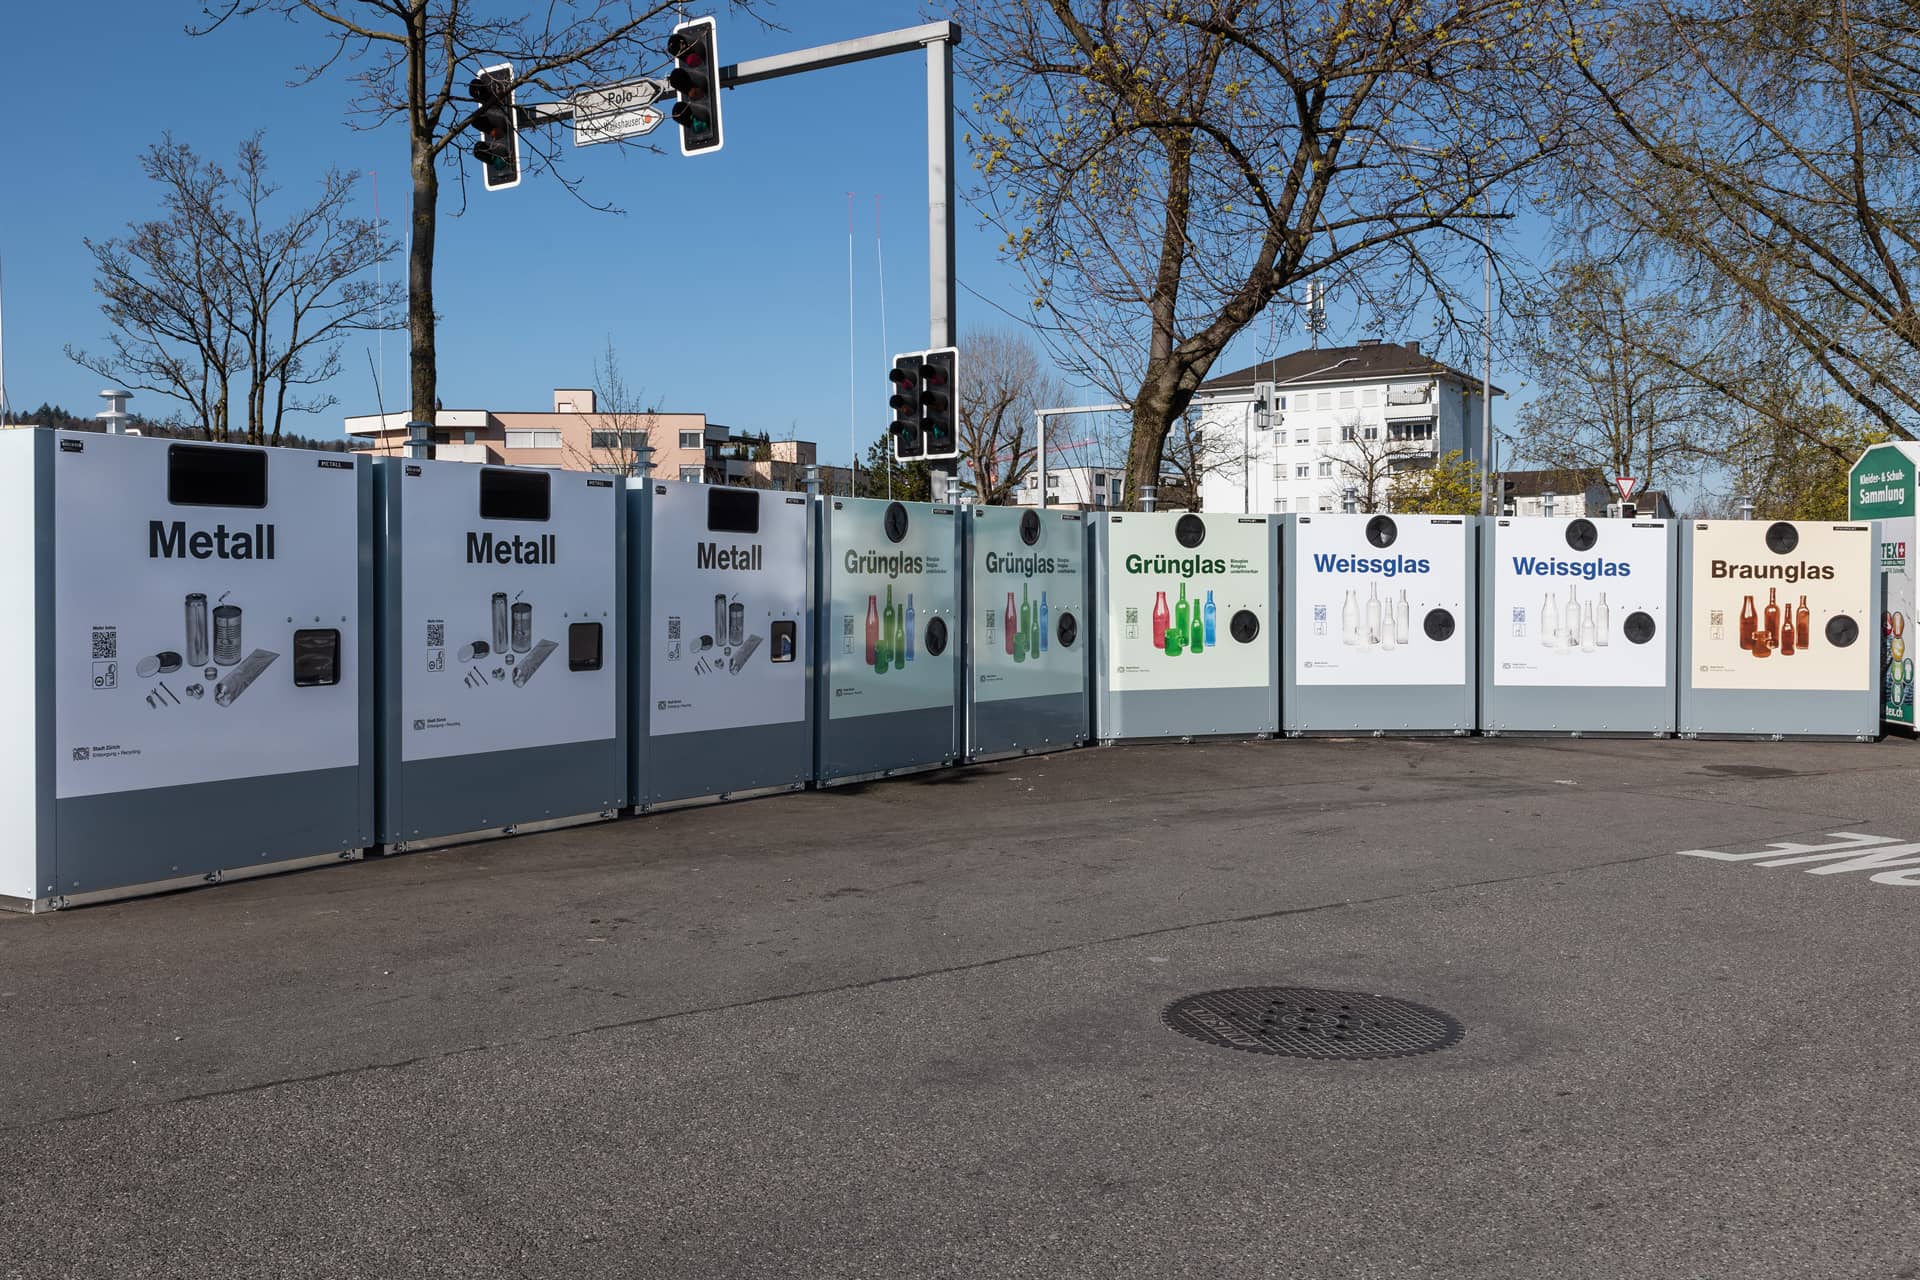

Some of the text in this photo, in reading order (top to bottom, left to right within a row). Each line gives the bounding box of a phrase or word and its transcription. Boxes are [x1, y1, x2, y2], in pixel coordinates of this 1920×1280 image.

[608, 89, 633, 106] Polo
[1860, 485, 1905, 505] Sammlung
[149, 520, 275, 560] Metall
[466, 531, 556, 565] Metall
[697, 542, 762, 571] Metall
[844, 549, 923, 579] Grünglas
[986, 551, 1055, 578] Grünglas
[1125, 553, 1226, 578] Grünglas
[1313, 553, 1431, 577] Weissglas
[1512, 556, 1631, 580] Weissglas
[1711, 560, 1835, 583] Braunglas
